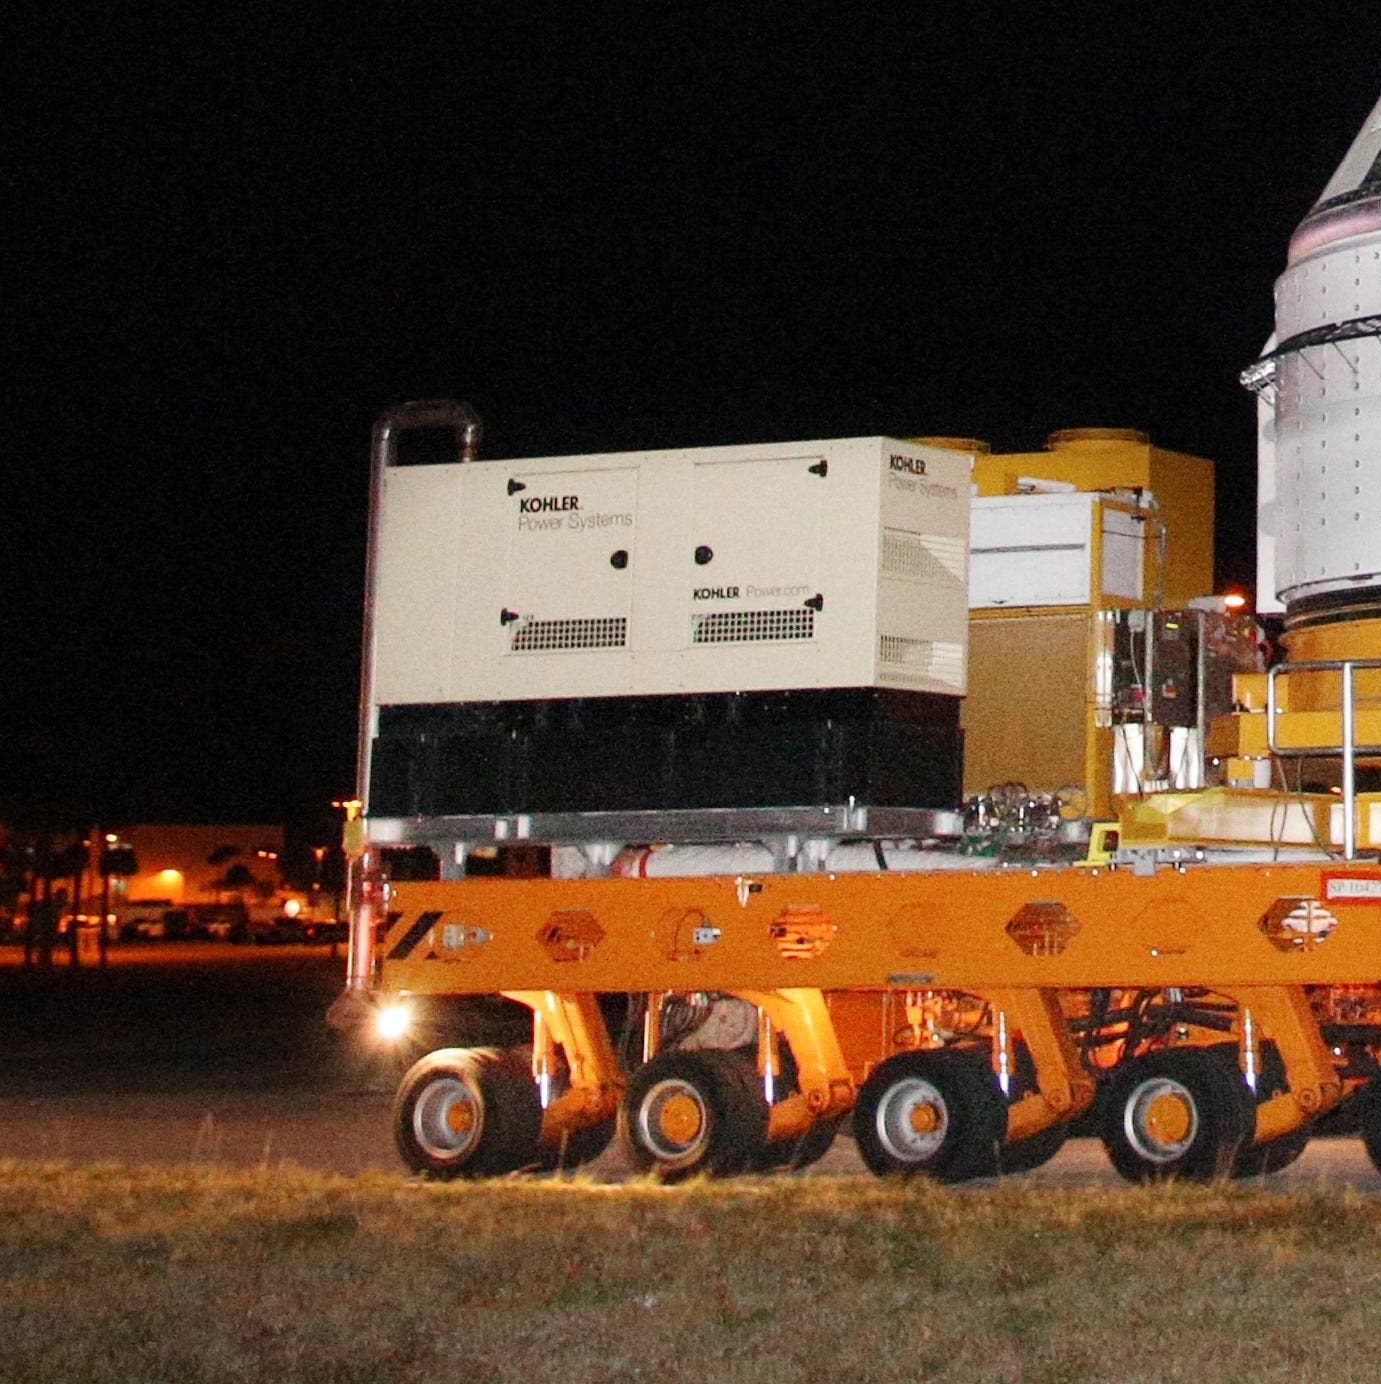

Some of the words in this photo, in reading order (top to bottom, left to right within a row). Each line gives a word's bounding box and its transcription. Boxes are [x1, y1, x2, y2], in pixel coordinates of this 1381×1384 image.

[890, 454, 926, 474] KOHLER
[520, 496, 579, 513] KOHLER
[518, 515, 563, 531] Power
[568, 513, 633, 532] Systems
[693, 586, 740, 600] KOHLER
